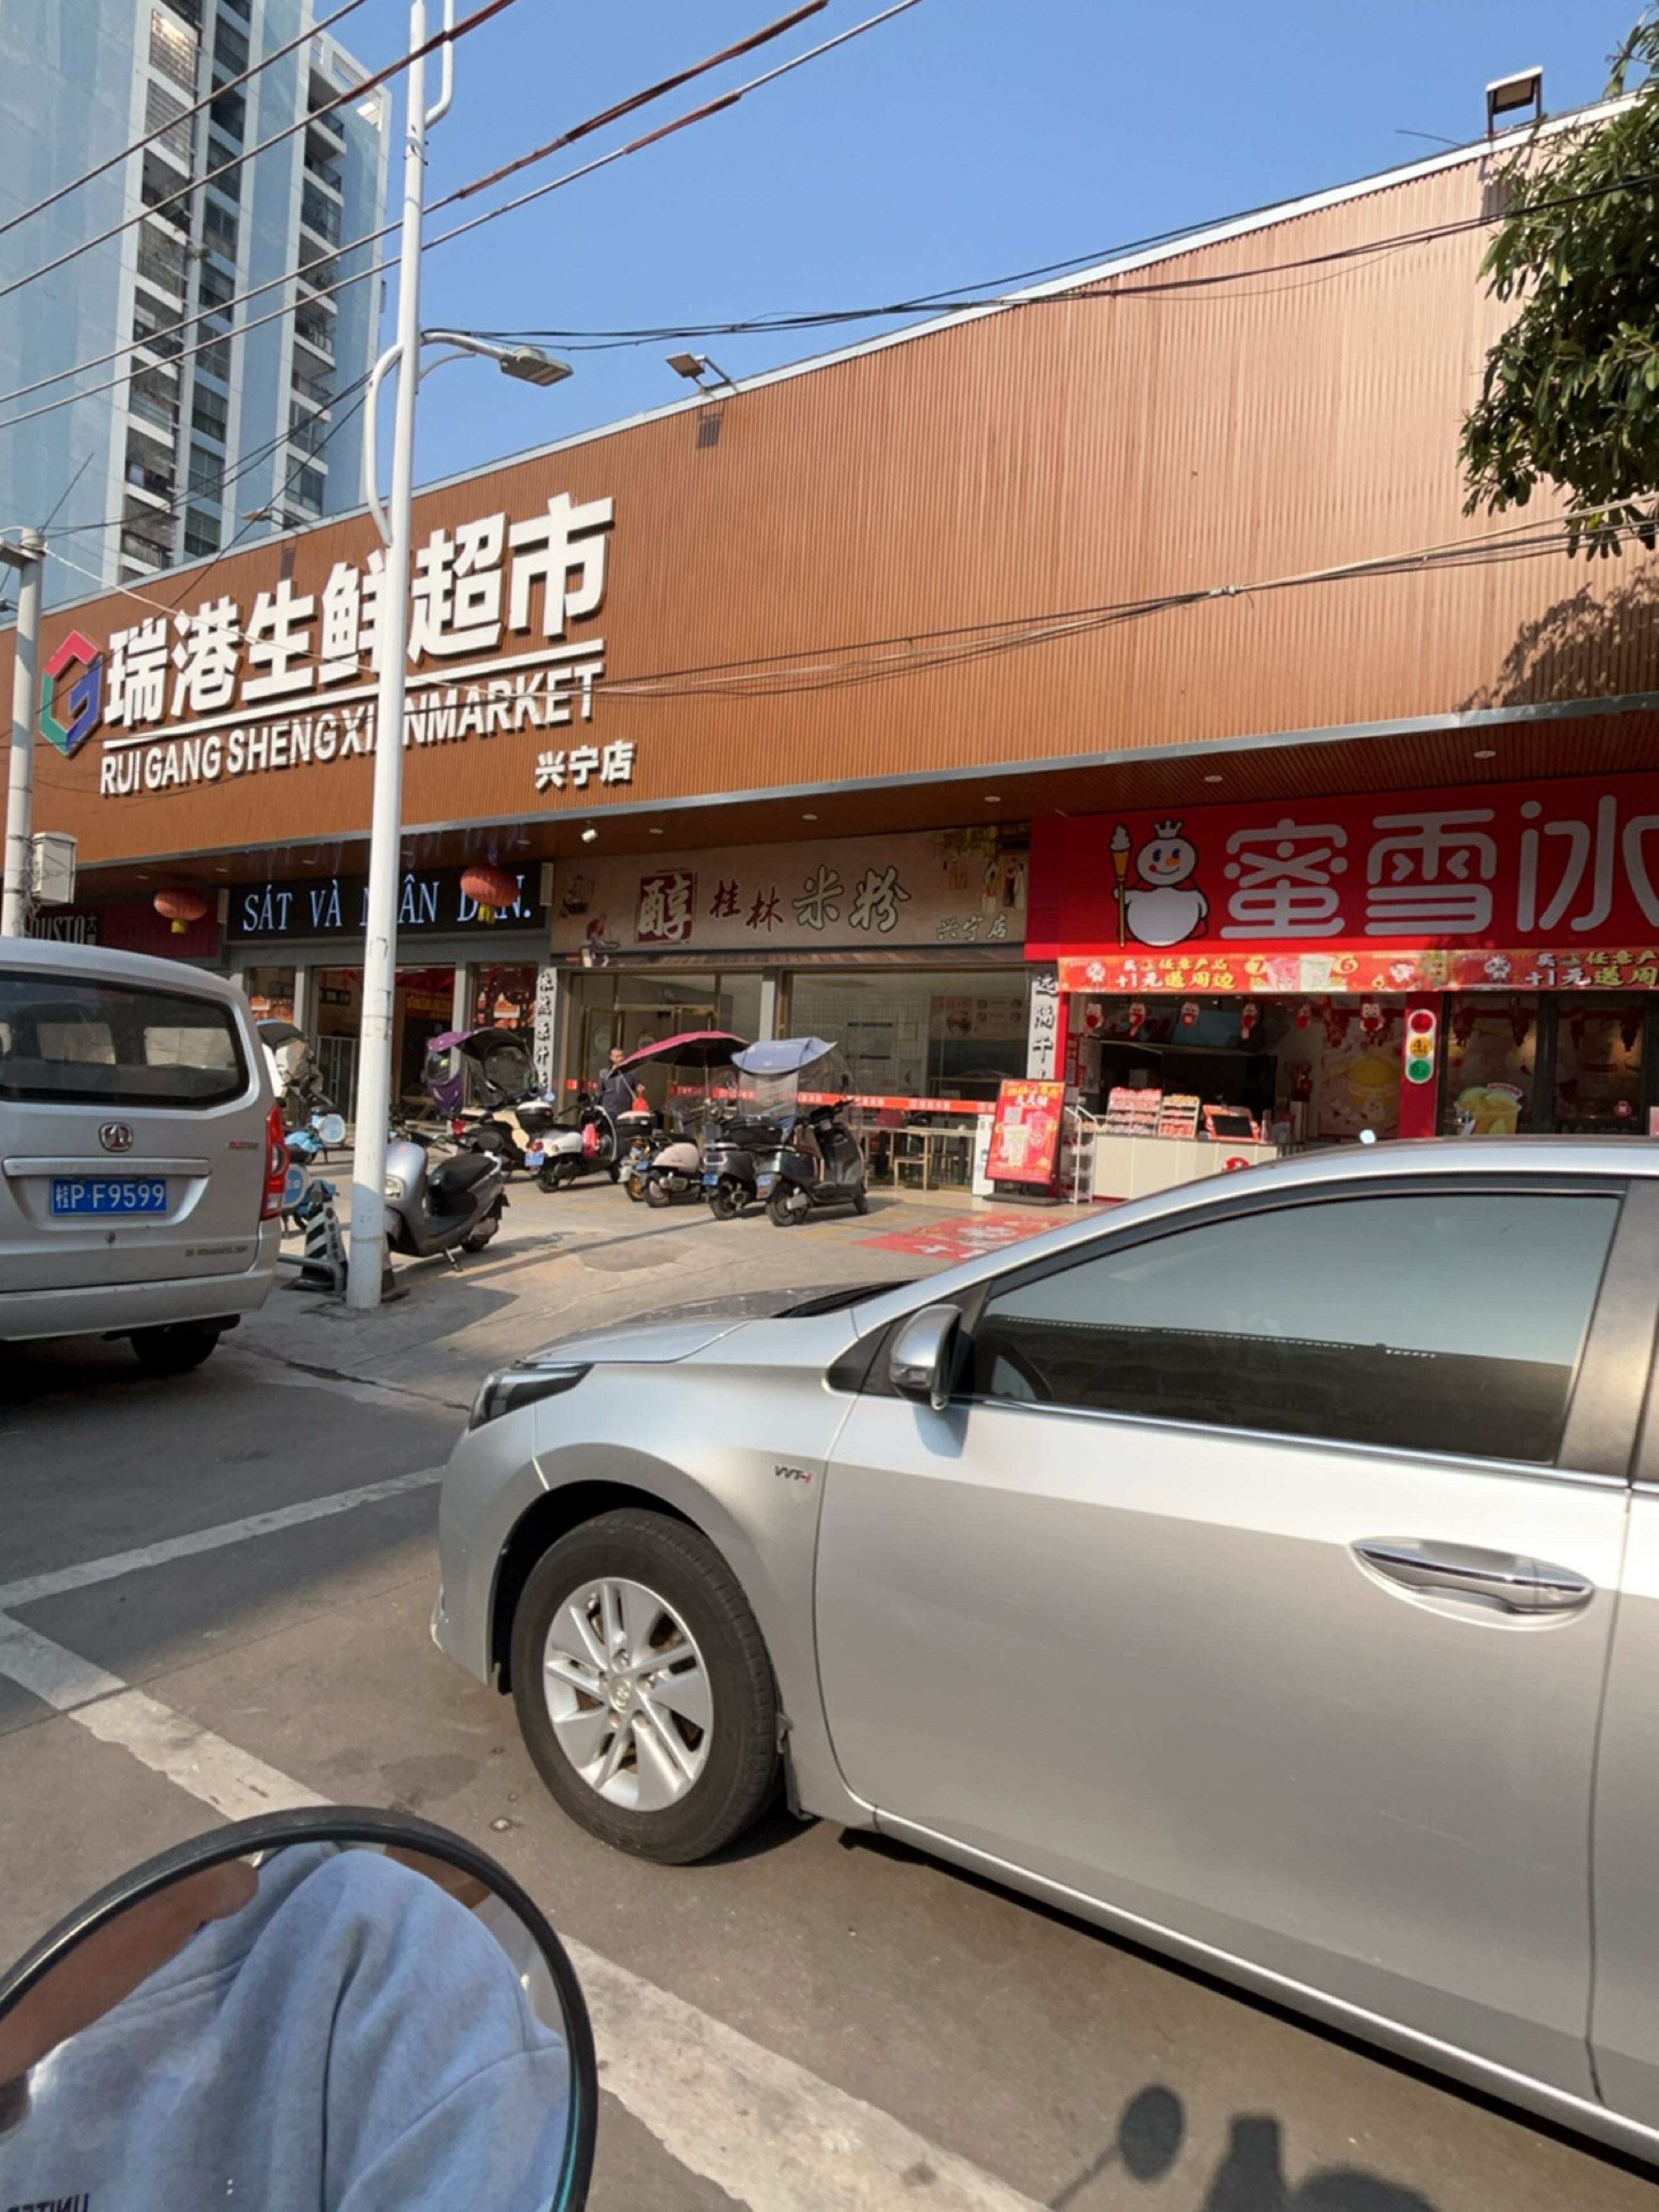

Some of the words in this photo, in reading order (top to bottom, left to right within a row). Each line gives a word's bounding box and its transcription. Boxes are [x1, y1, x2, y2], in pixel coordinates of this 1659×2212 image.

[104, 492, 613, 728] 瑞港生鲜超市
[226, 662, 605, 774] SHENGXINMARKET
[534, 739, 635, 790] 兴宁店
[1219, 795, 1659, 939] 蜜雪冰
[243, 884, 293, 932] SÁT
[310, 879, 342, 927] VÀ
[360, 874, 440, 924] ÂN
[456, 874, 532, 922] DN.
[637, 874, 693, 940] 醇
[937, 913, 1007, 941] 兴宁店
